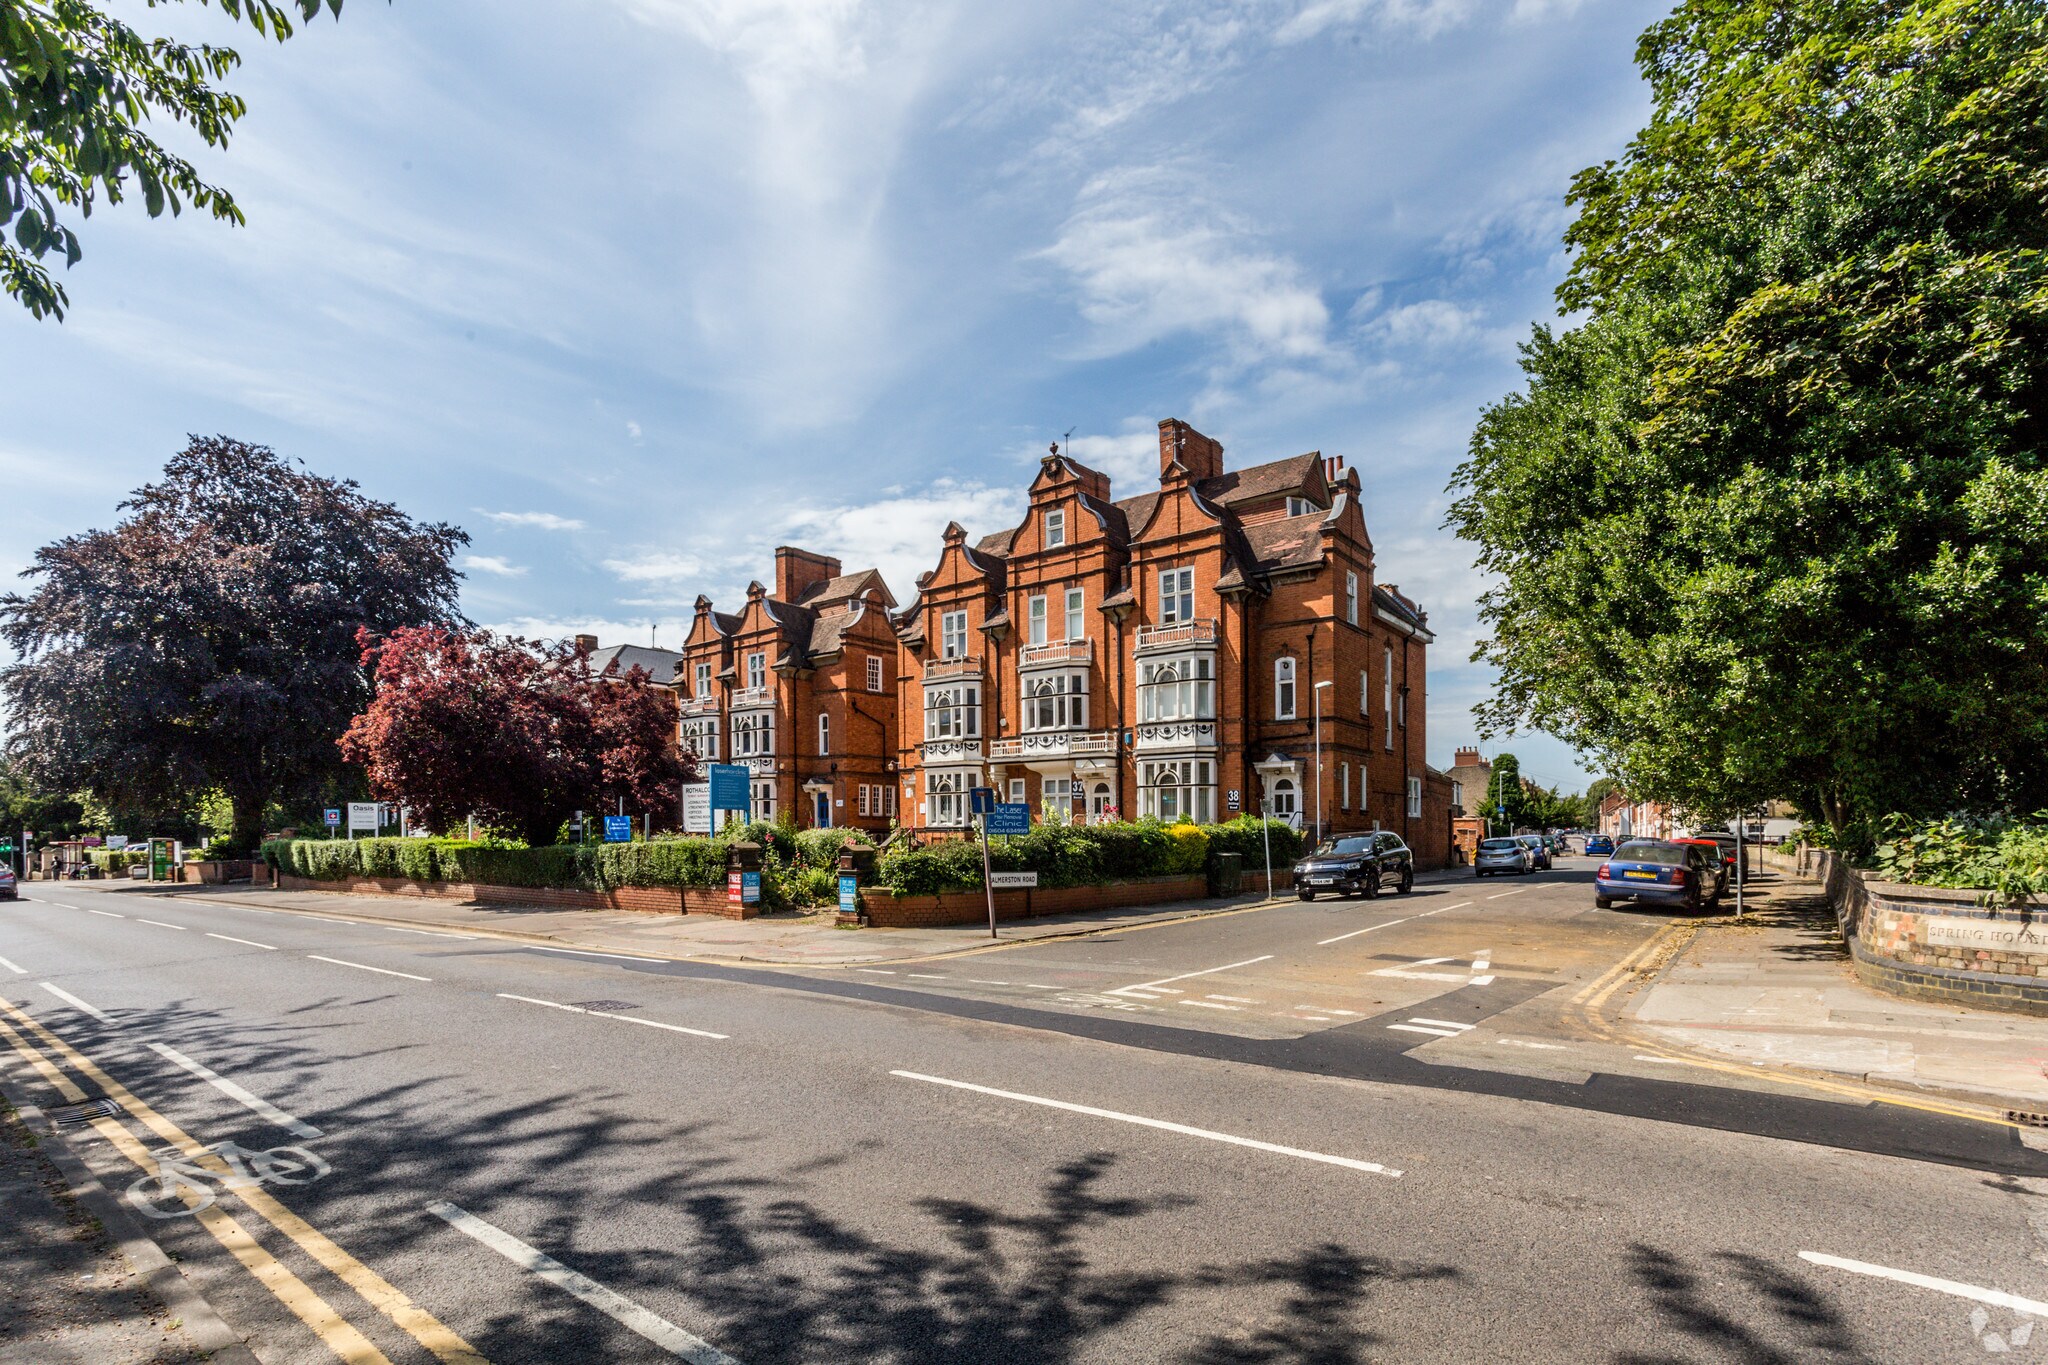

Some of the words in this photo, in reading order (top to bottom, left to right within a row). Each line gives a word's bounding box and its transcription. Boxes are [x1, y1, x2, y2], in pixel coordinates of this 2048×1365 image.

[1072, 781, 1083, 792] 37
[1228, 790, 1239, 801] 38
[1005, 805, 1022, 814] Laser
[728, 874, 741, 883] FREE
[1929, 926, 1984, 940] SPRING
